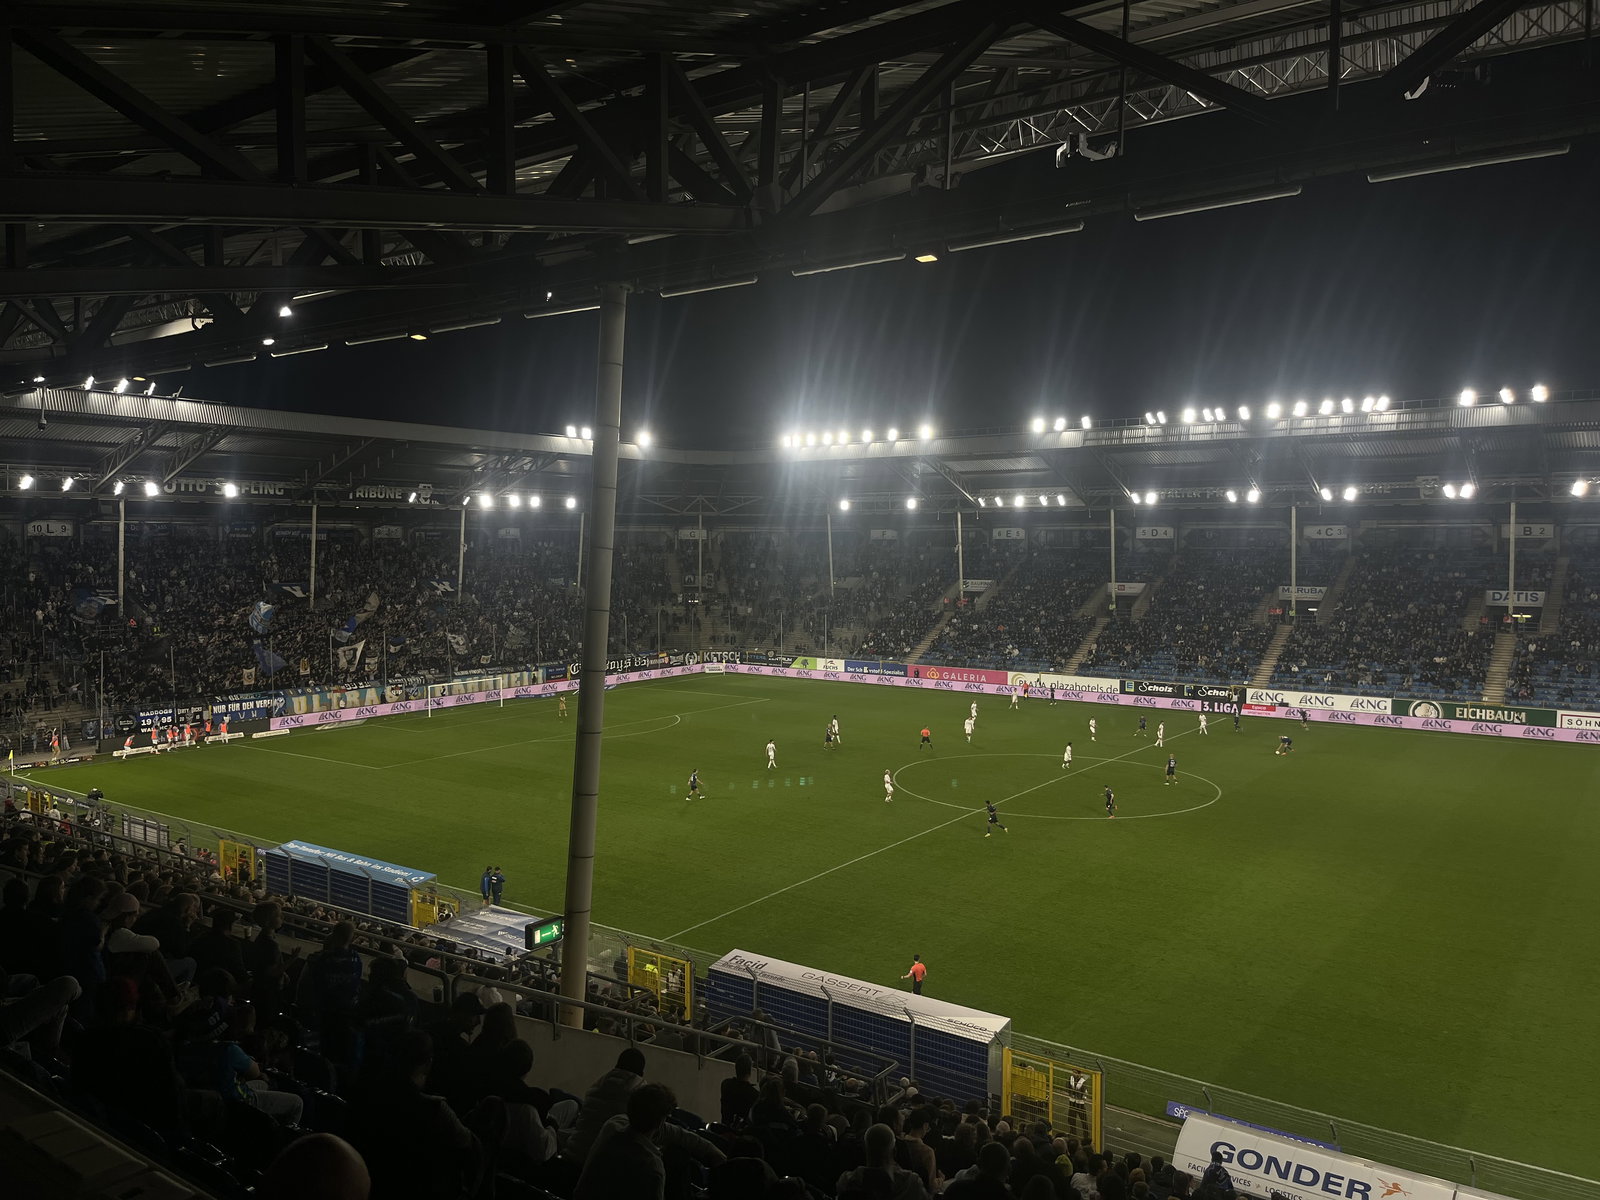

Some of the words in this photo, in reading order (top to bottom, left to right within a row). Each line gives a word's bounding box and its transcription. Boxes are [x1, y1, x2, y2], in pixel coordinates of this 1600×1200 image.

[47, 524, 54, 534] L
[61, 525, 67, 533] 9
[1006, 529, 1012, 538] E
[1151, 528, 1159, 537] D
[1325, 528, 1333, 537] C
[1523, 527, 1532, 536] B
[943, 672, 987, 682] GALERIA
[1302, 695, 1335, 706] RNG
[1355, 698, 1388, 710] RNG
[213, 704, 227, 714] NUR
[228, 702, 241, 712] FÜR
[242, 701, 255, 711] DEN
[1203, 702, 1212, 712] 3.
[139, 709, 173, 717] MADDOGS
[141, 718, 152, 726] 19
[729, 955, 769, 970] Facid
[802, 972, 883, 997] GASSERT
[1210, 1141, 1371, 1200] GONDER
